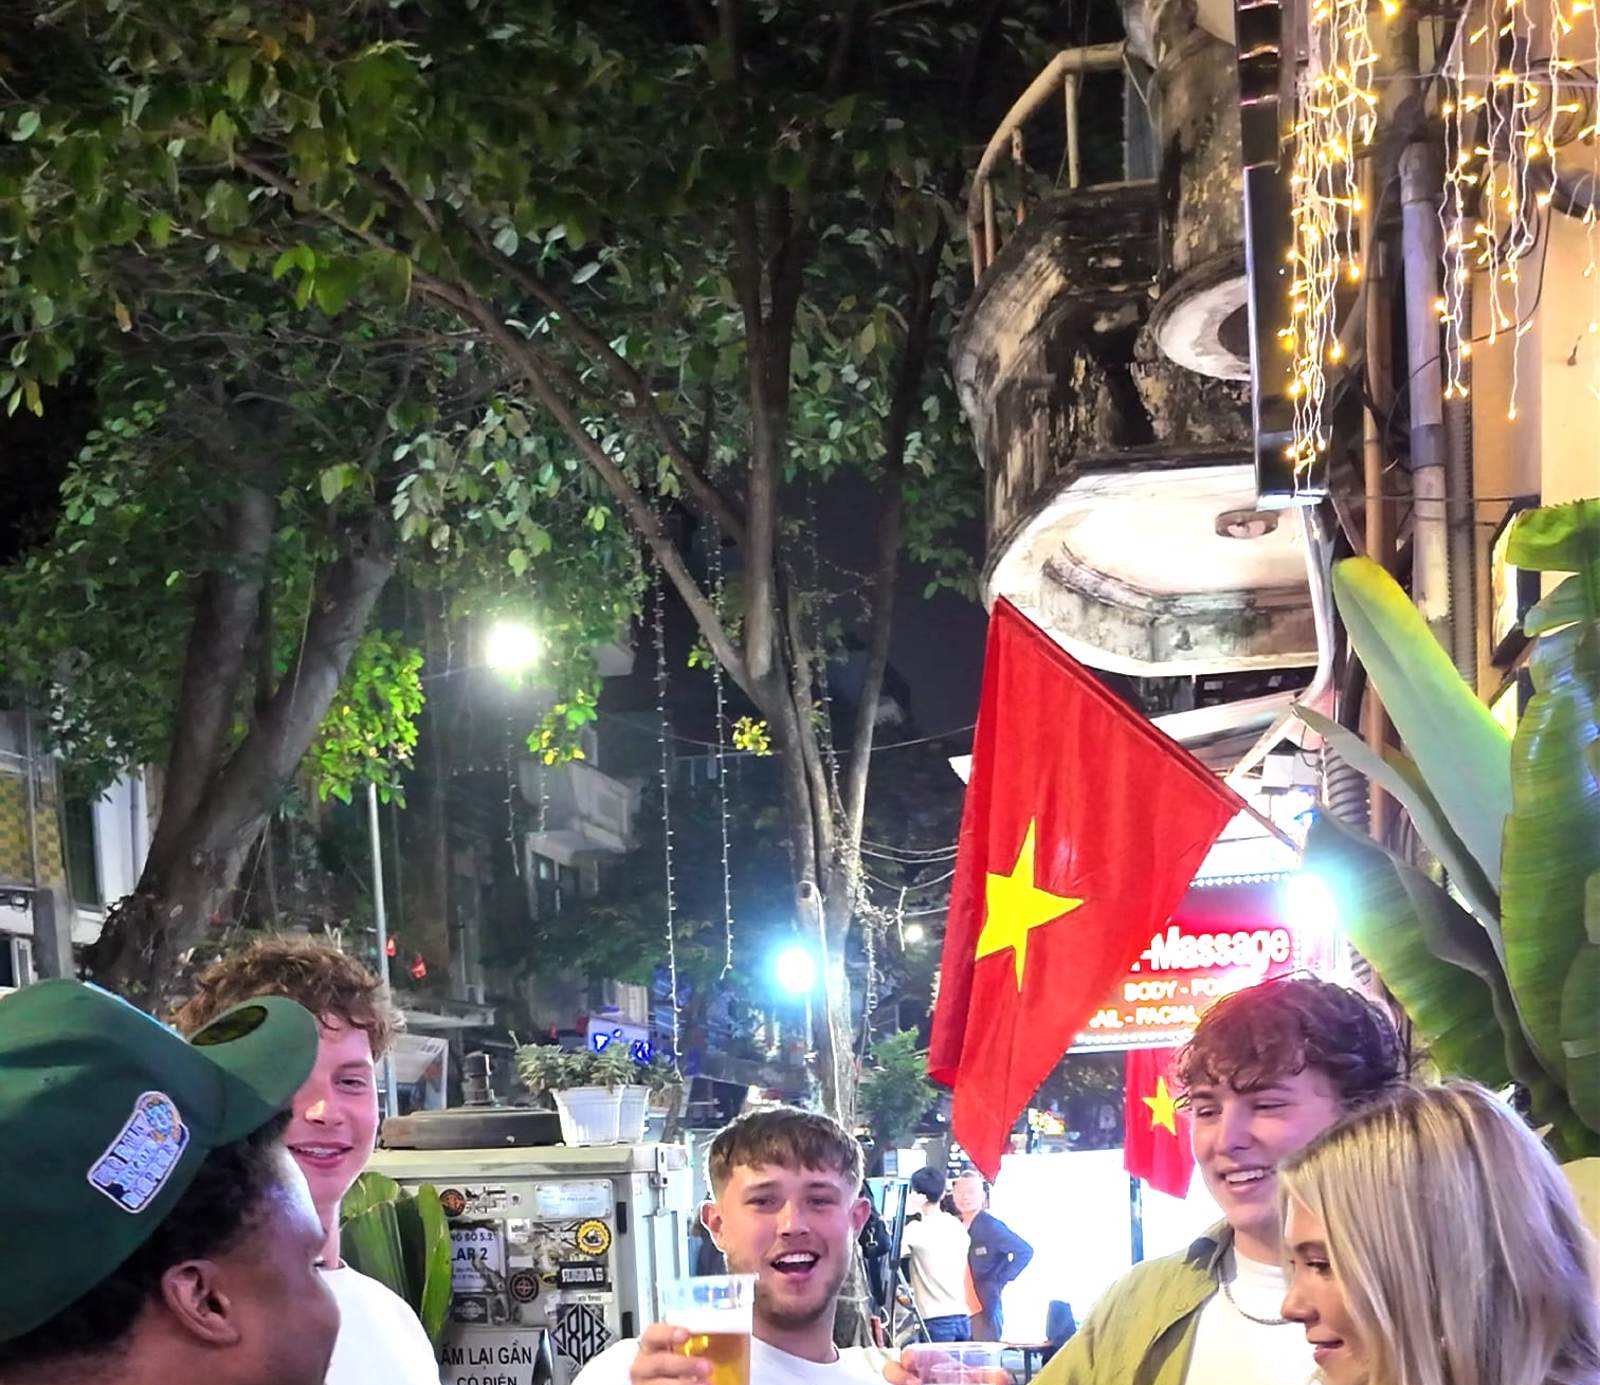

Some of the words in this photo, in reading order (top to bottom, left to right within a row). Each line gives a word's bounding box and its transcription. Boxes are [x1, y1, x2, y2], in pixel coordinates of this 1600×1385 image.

[1131, 926, 1291, 975] -Massage
[1124, 981, 1178, 1002] BODY
[1089, 1008, 1124, 1029] AIL
[480, 1247, 488, 1260] 2
[468, 1346, 494, 1370] LẠI
